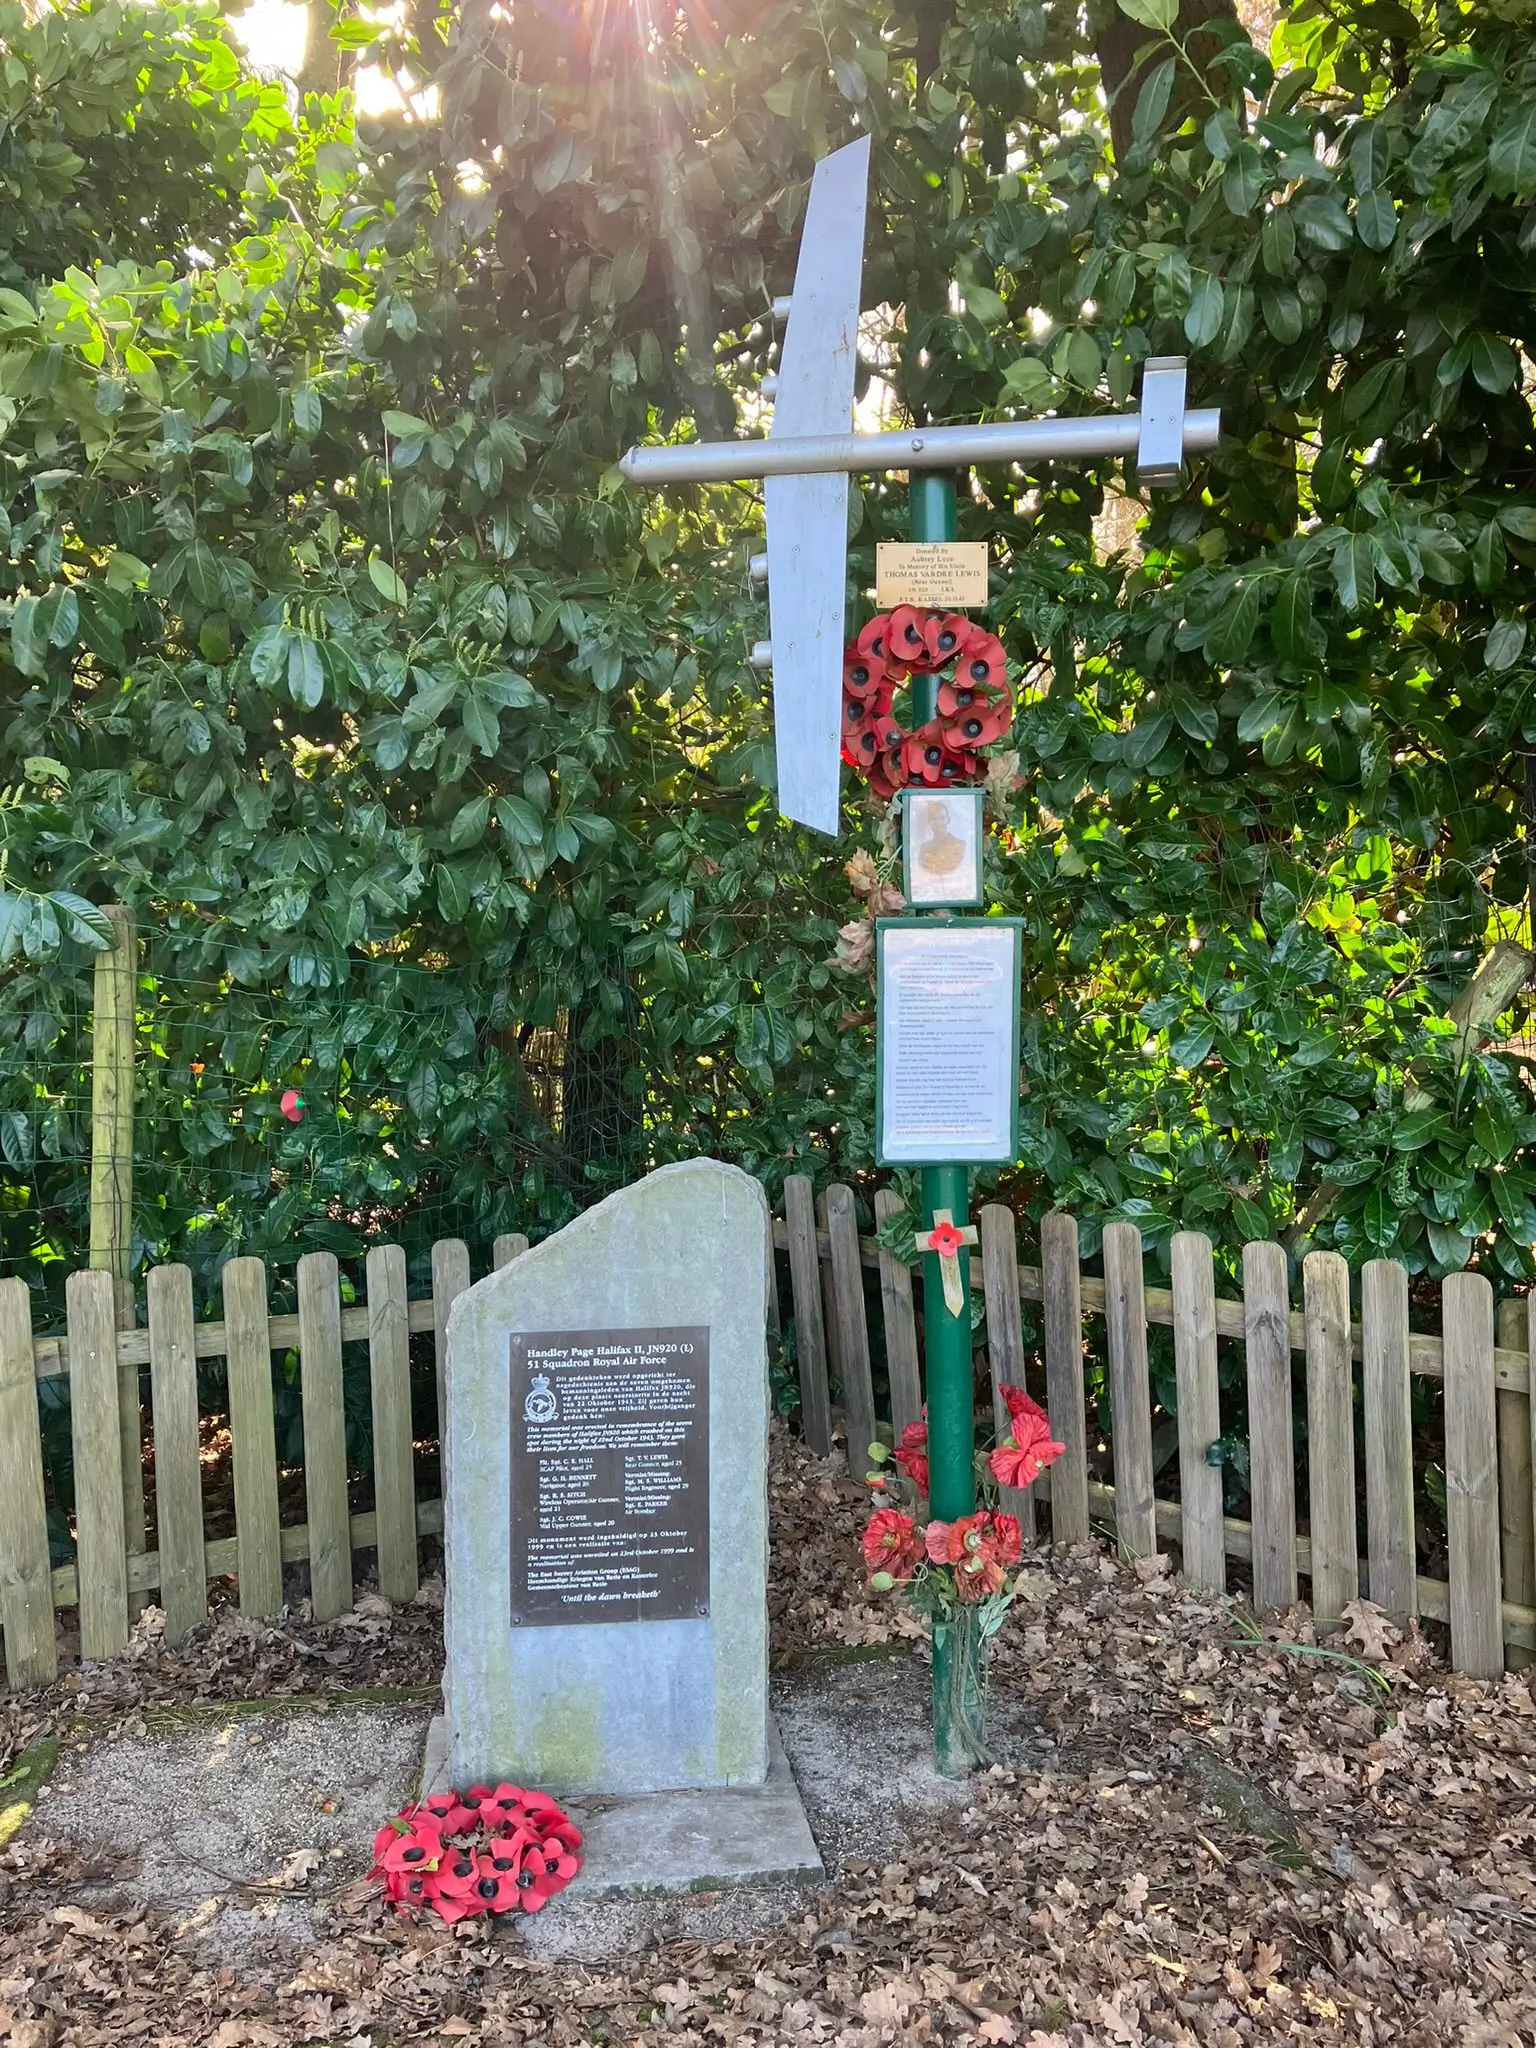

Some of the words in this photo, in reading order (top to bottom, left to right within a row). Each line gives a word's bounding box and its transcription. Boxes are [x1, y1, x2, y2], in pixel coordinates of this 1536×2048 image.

[527, 1348, 568, 1358] Handley
[572, 1348, 593, 1357] Page
[597, 1346, 631, 1355] Halifax
[634, 1346, 645, 1354] II,
[647, 1344, 677, 1355] JN920
[680, 1344, 693, 1353] (L)
[528, 1360, 539, 1369] 51
[543, 1359, 590, 1370] Squadron
[593, 1357, 620, 1367] Royal
[623, 1357, 637, 1365] Air
[640, 1356, 667, 1364] Force
[569, 1374, 611, 1382] gedenkteken
[556, 1381, 603, 1389] nagedachtenis
[561, 1387, 619, 1395] bemanningsleden
